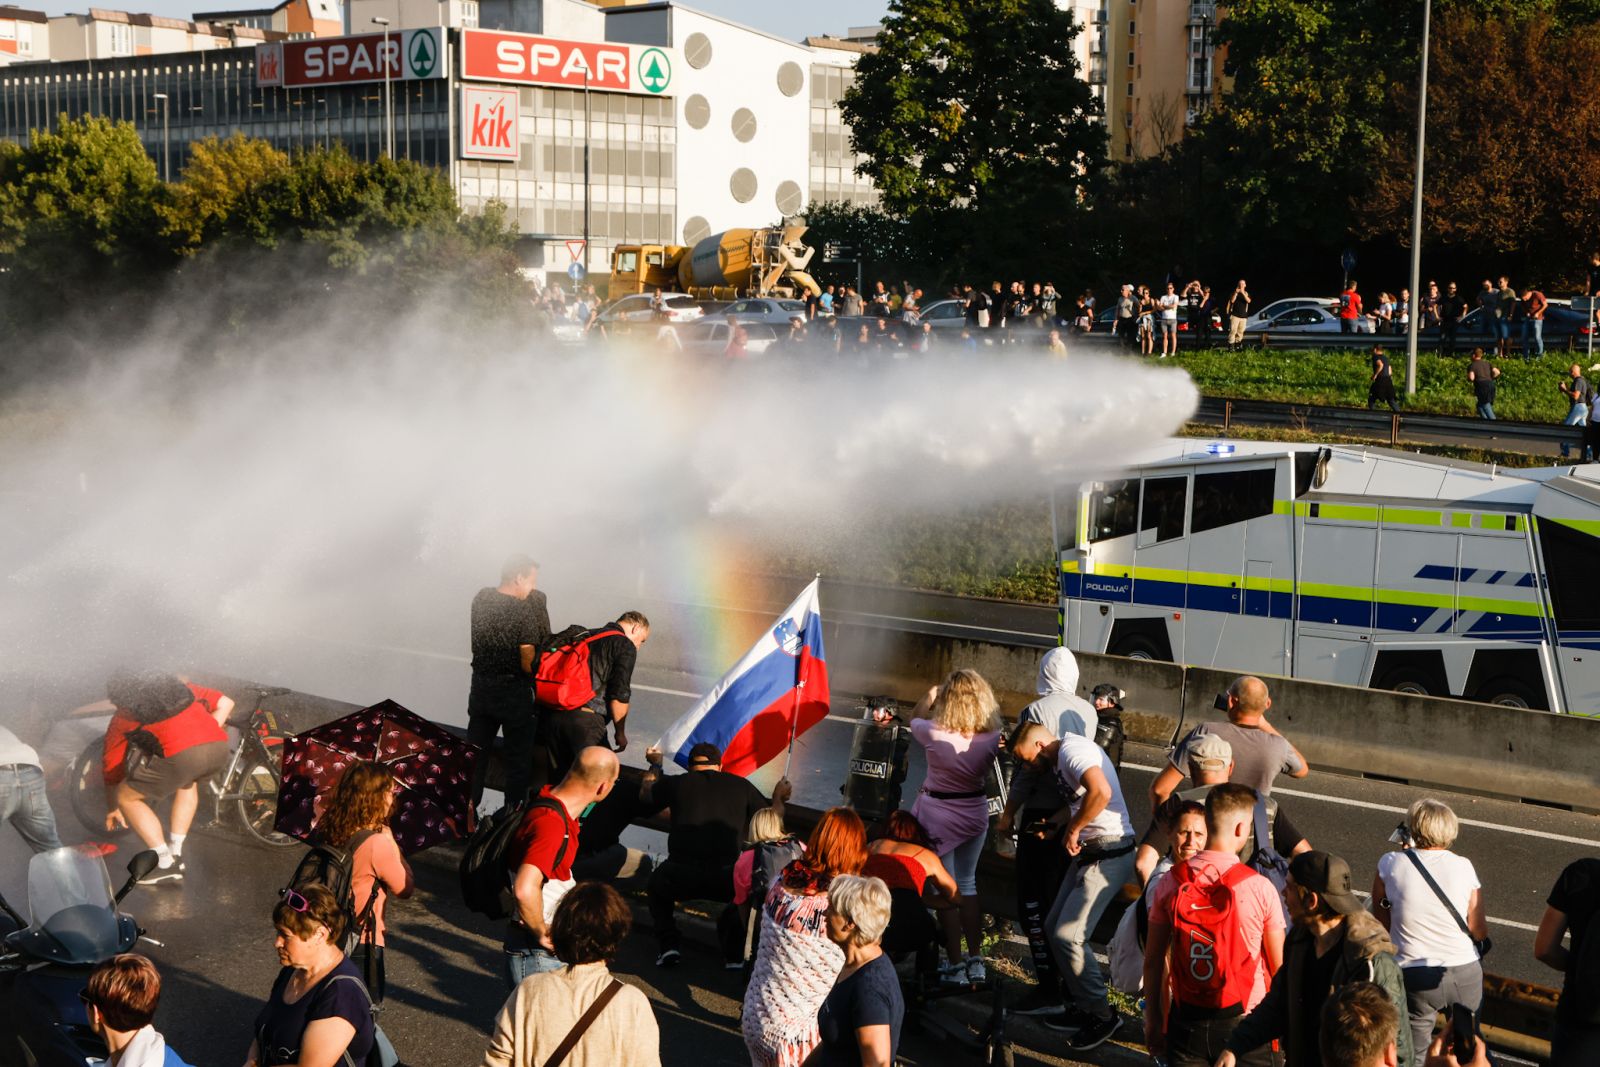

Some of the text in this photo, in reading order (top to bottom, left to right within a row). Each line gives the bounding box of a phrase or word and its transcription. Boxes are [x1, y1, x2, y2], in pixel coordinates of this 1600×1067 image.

[259, 51, 278, 81] kik
[304, 40, 400, 78] SPAR
[496, 41, 627, 83] SPAR
[471, 99, 513, 148] kik
[1086, 583, 1126, 593] POLICIJA
[1190, 929, 1214, 980] CR7
